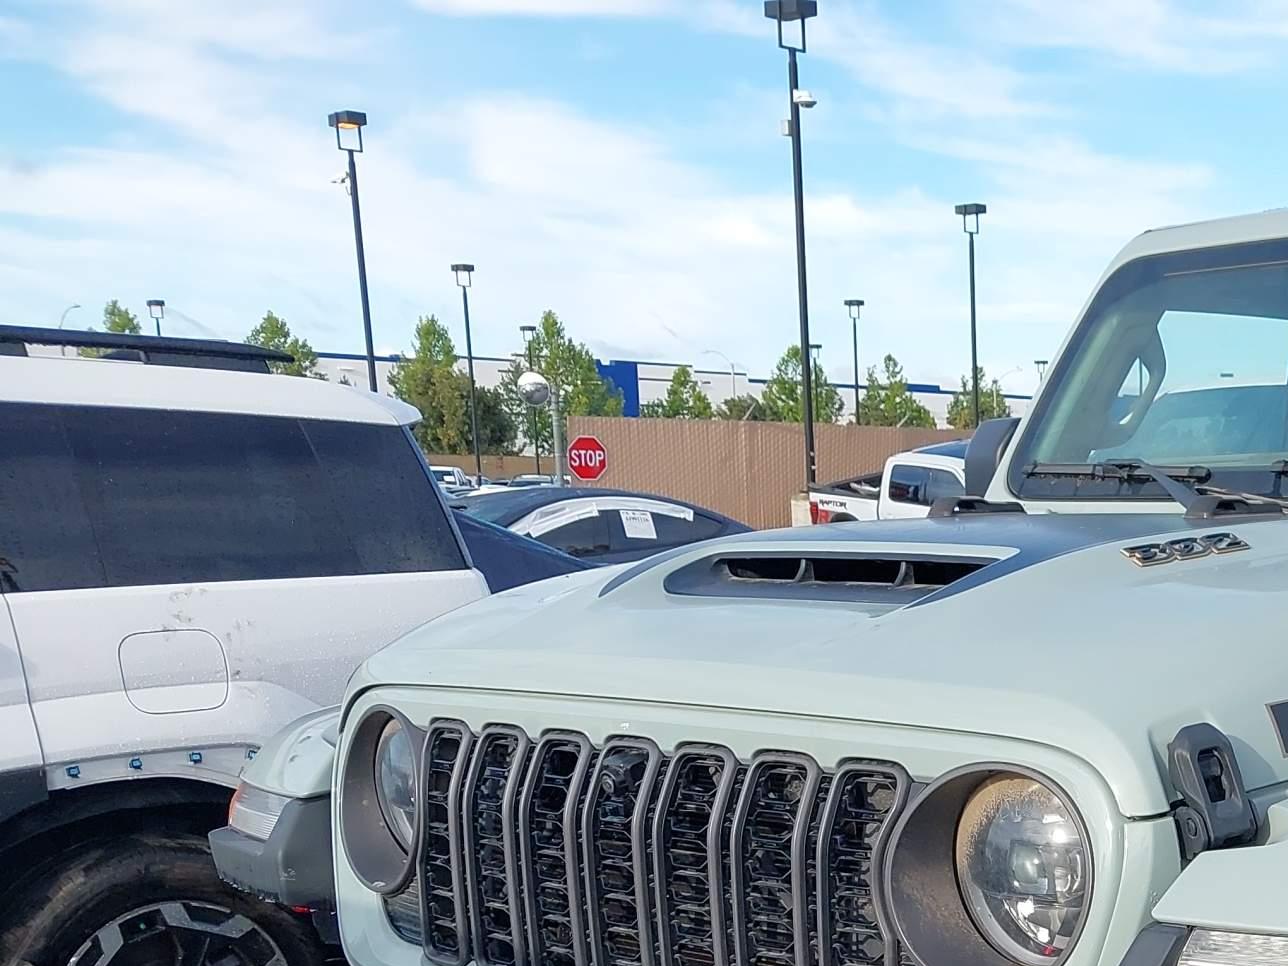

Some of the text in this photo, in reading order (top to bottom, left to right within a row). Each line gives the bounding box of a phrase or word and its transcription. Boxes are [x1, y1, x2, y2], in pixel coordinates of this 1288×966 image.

[570, 449, 604, 467] STOP
[819, 499, 849, 511] RAPTOR
[1119, 532, 1252, 568] 392
